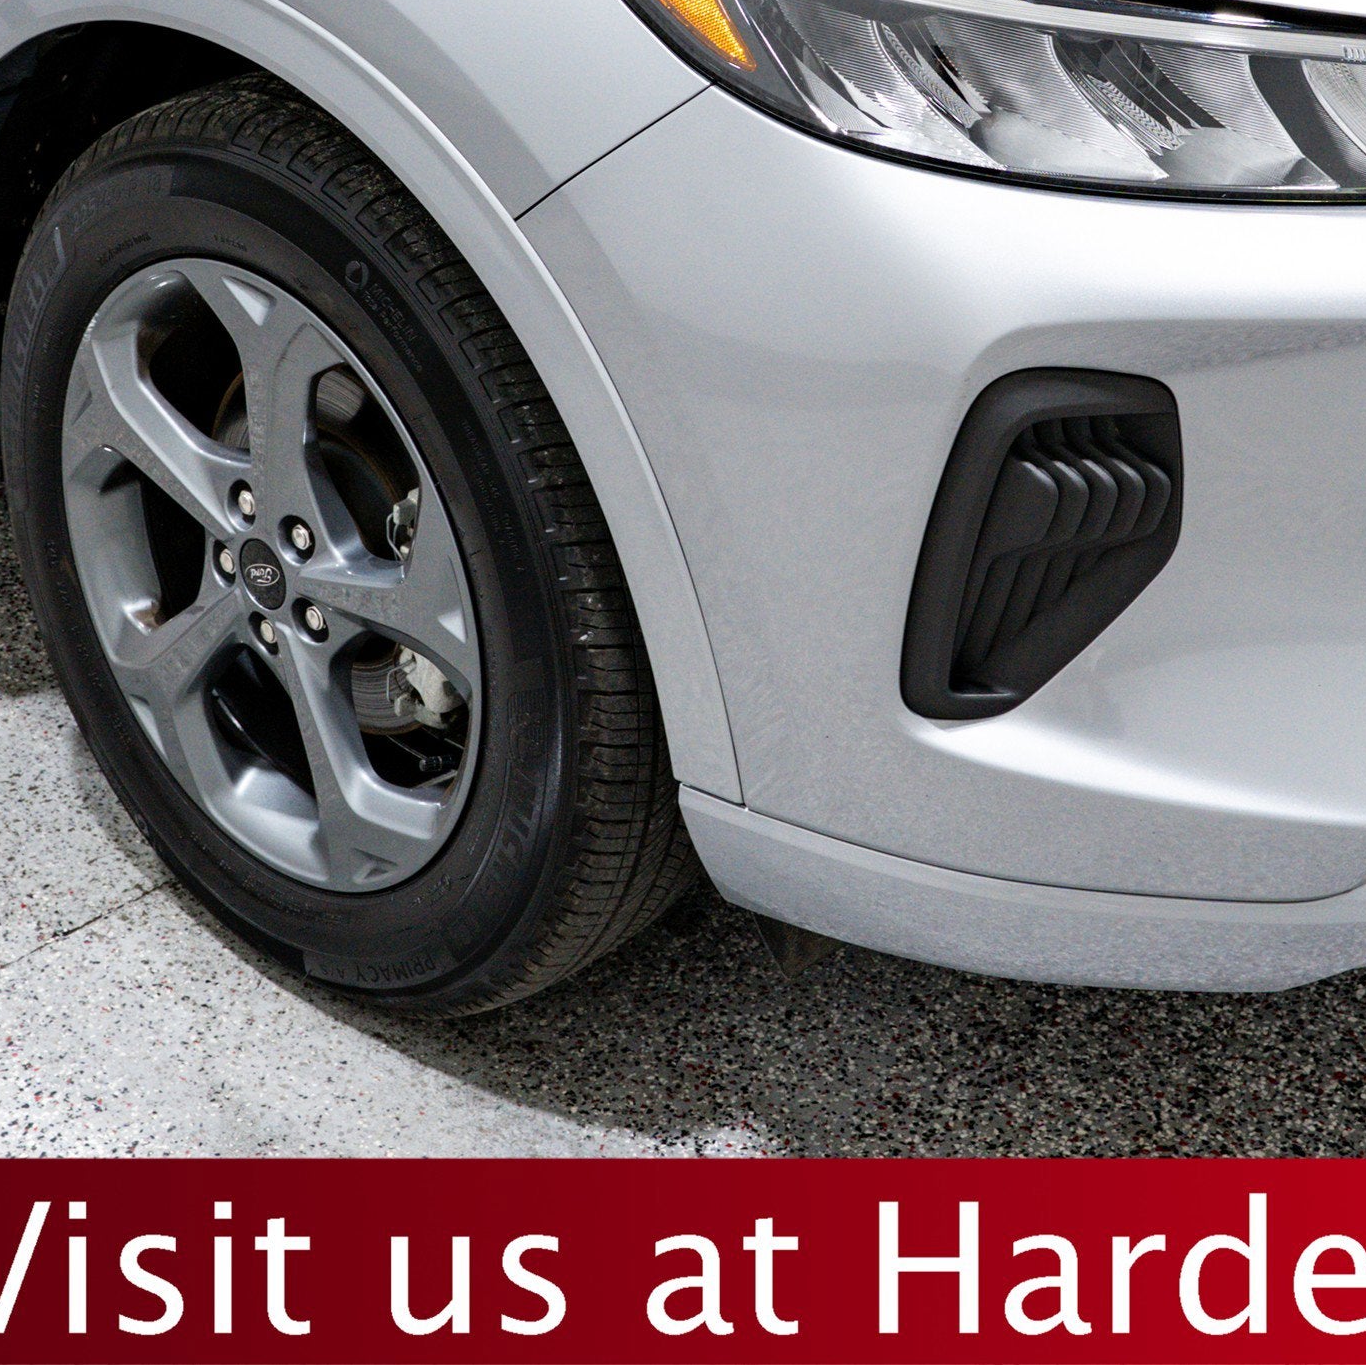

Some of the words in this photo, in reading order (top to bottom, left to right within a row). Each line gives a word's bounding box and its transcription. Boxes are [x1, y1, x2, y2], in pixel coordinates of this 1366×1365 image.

[368, 282, 418, 341] MICHELIN
[378, 310, 424, 372] Performance
[249, 568, 273, 584] Ford
[356, 952, 436, 983] PRIMACY
